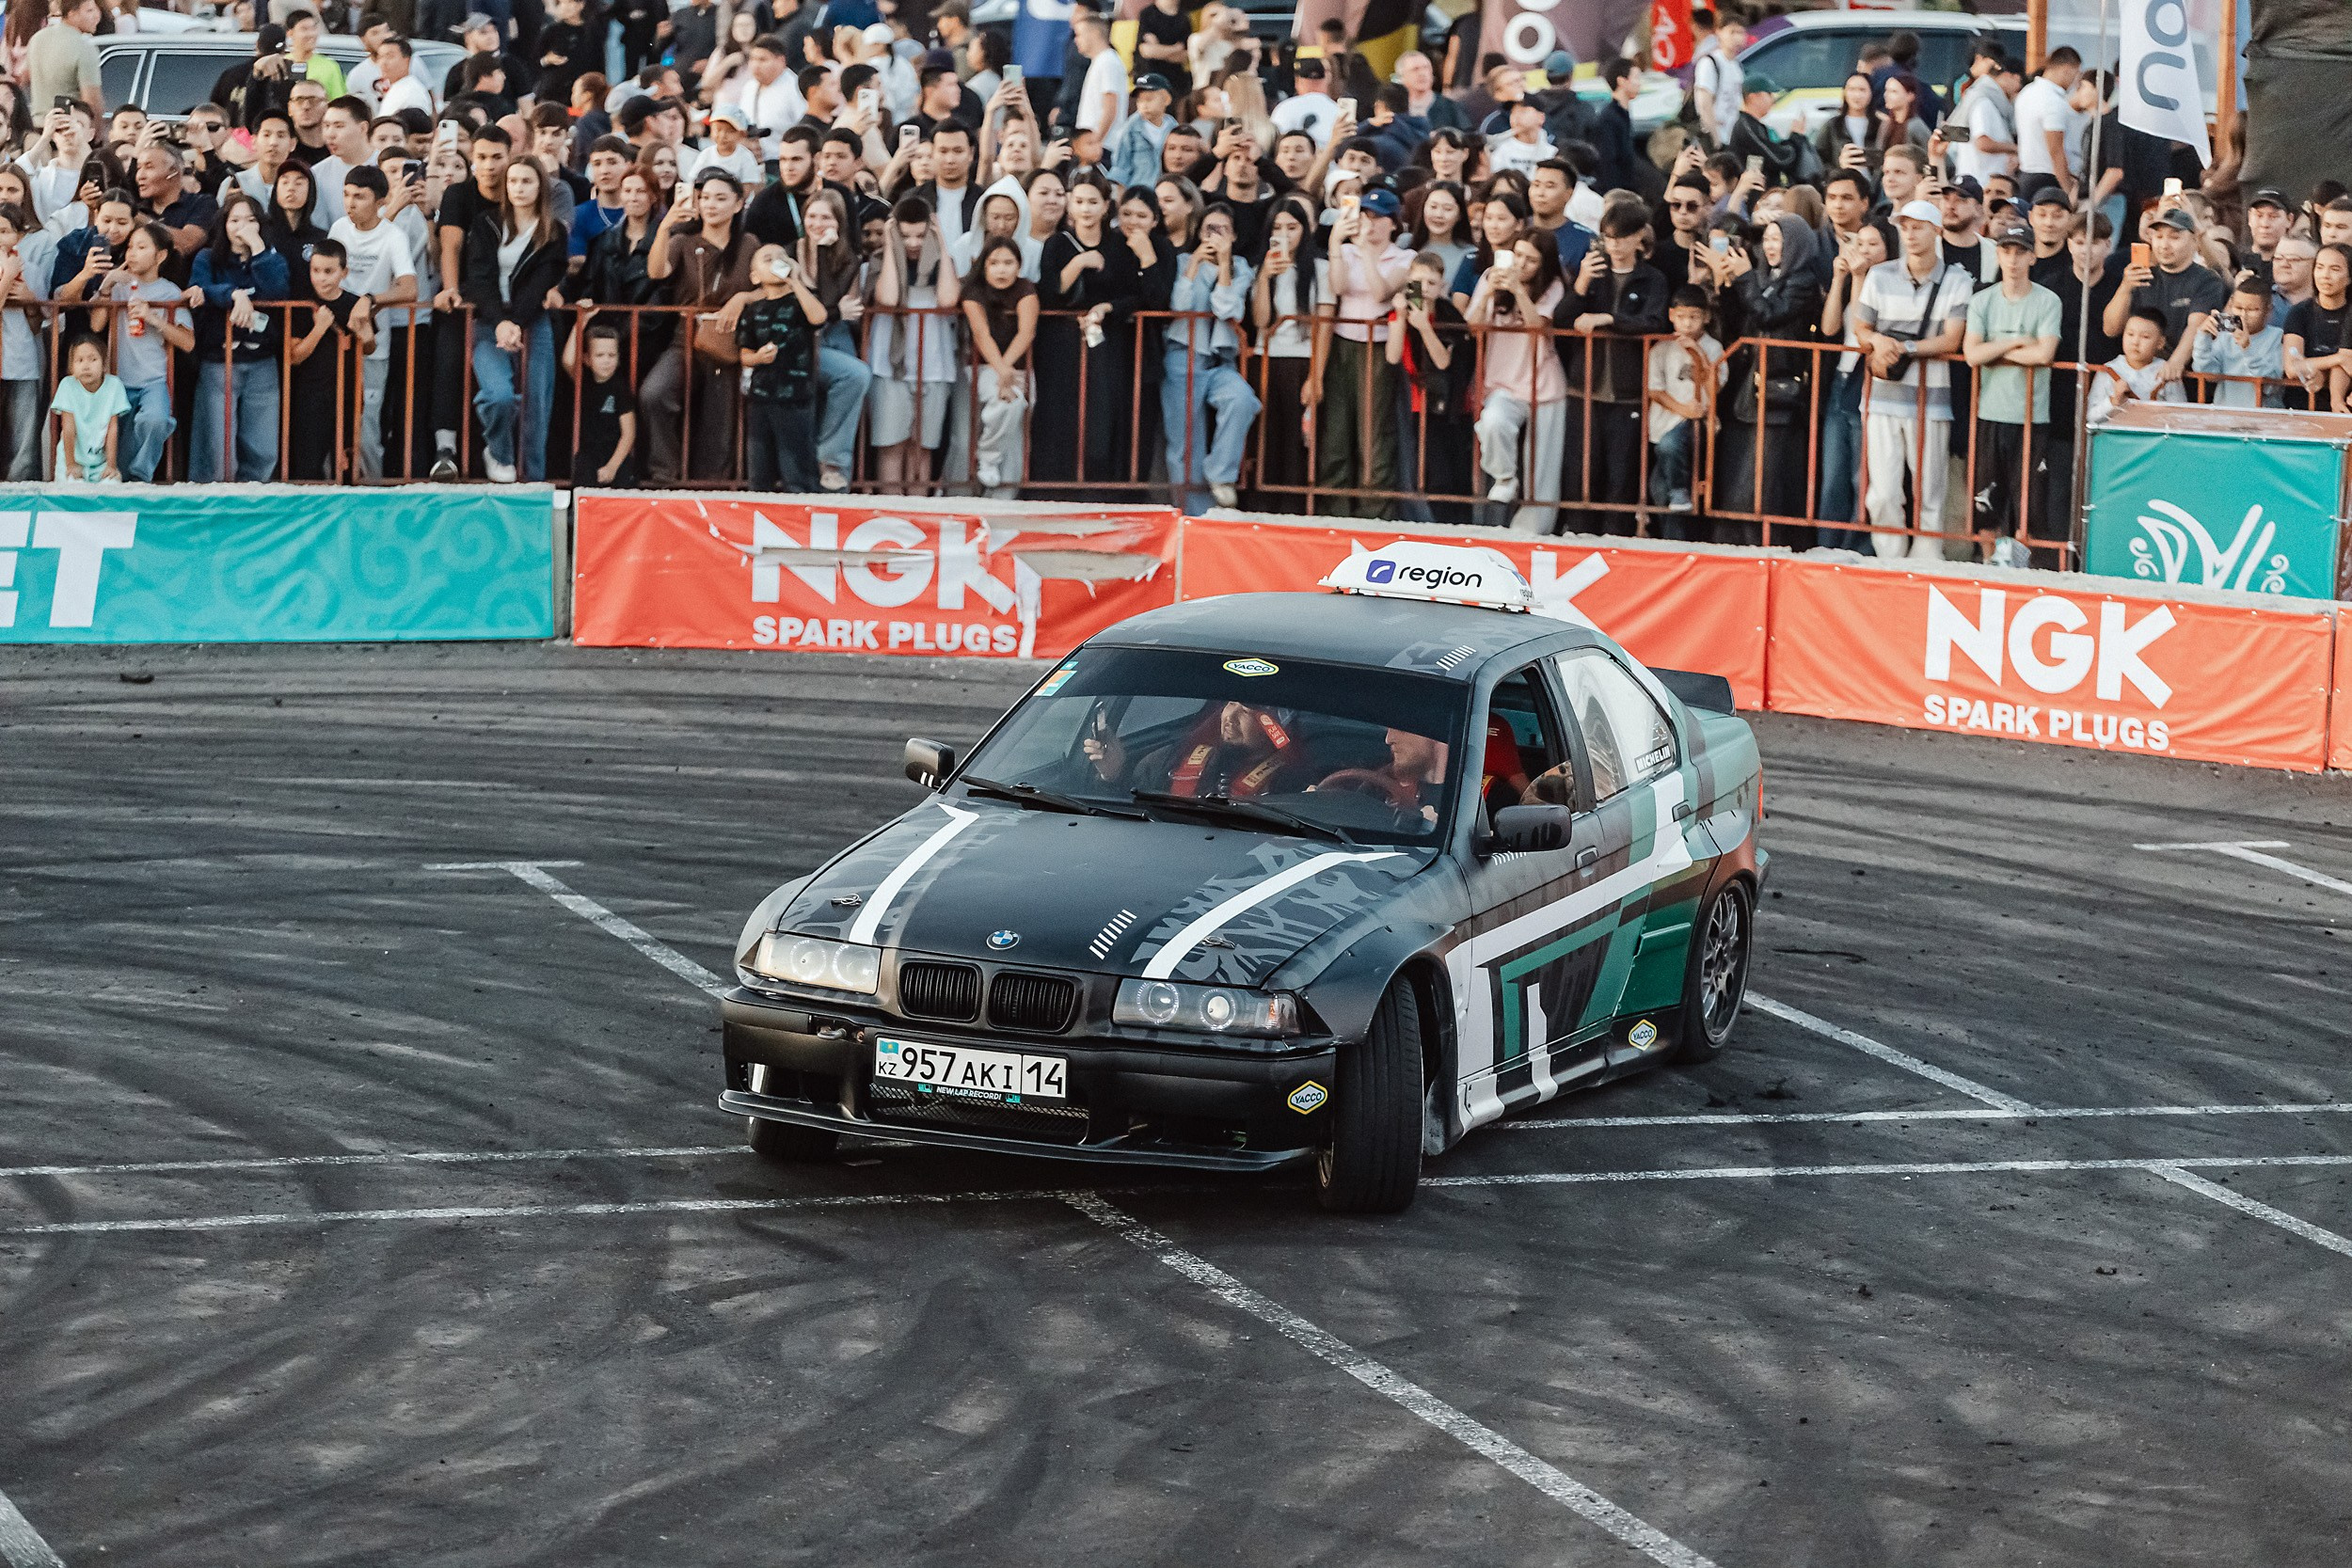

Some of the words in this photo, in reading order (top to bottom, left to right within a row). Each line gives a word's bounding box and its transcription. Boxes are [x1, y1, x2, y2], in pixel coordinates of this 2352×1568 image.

[752, 511, 1021, 615] NGK
[1398, 565, 1483, 590] region
[753, 616, 880, 650] SPARK
[888, 621, 1017, 654] PLUGS
[1925, 582, 2177, 710] NGK
[1233, 663, 1270, 672] YACCO
[1924, 693, 2042, 737] SPARK
[2048, 708, 2170, 752] PLUGS
[1636, 745, 1671, 771] MICHELIN
[879, 1061, 898, 1076] KZ
[901, 1047, 957, 1083] 957
[1025, 1061, 1063, 1095] 14
[936, 1085, 955, 1096] NEW
[1295, 1092, 1323, 1104] YACCO
